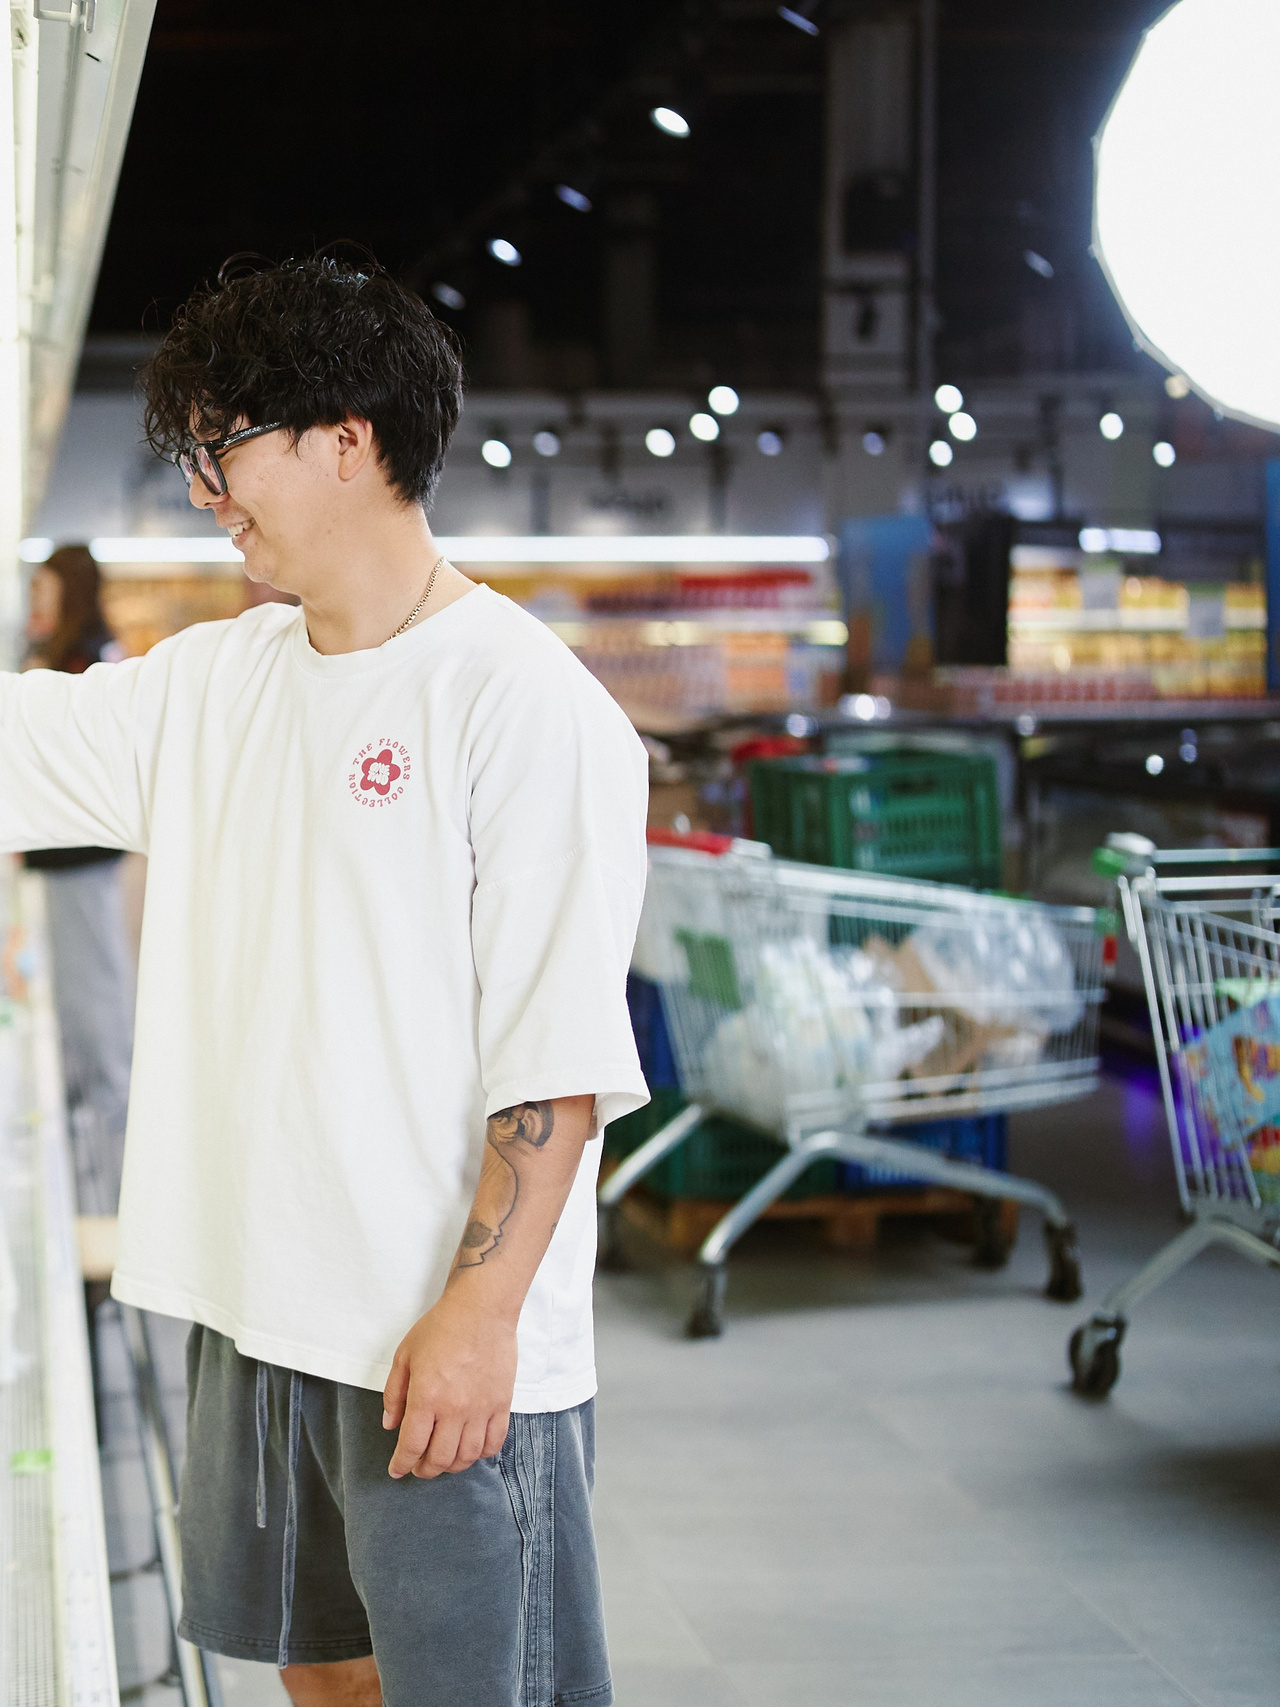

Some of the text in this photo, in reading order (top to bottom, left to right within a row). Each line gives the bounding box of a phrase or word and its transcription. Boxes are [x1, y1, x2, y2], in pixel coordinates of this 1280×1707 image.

[352, 743, 373, 766] THE
[378, 738, 411, 781] FLOWERS
[348, 773, 404, 808] COLLECTION
